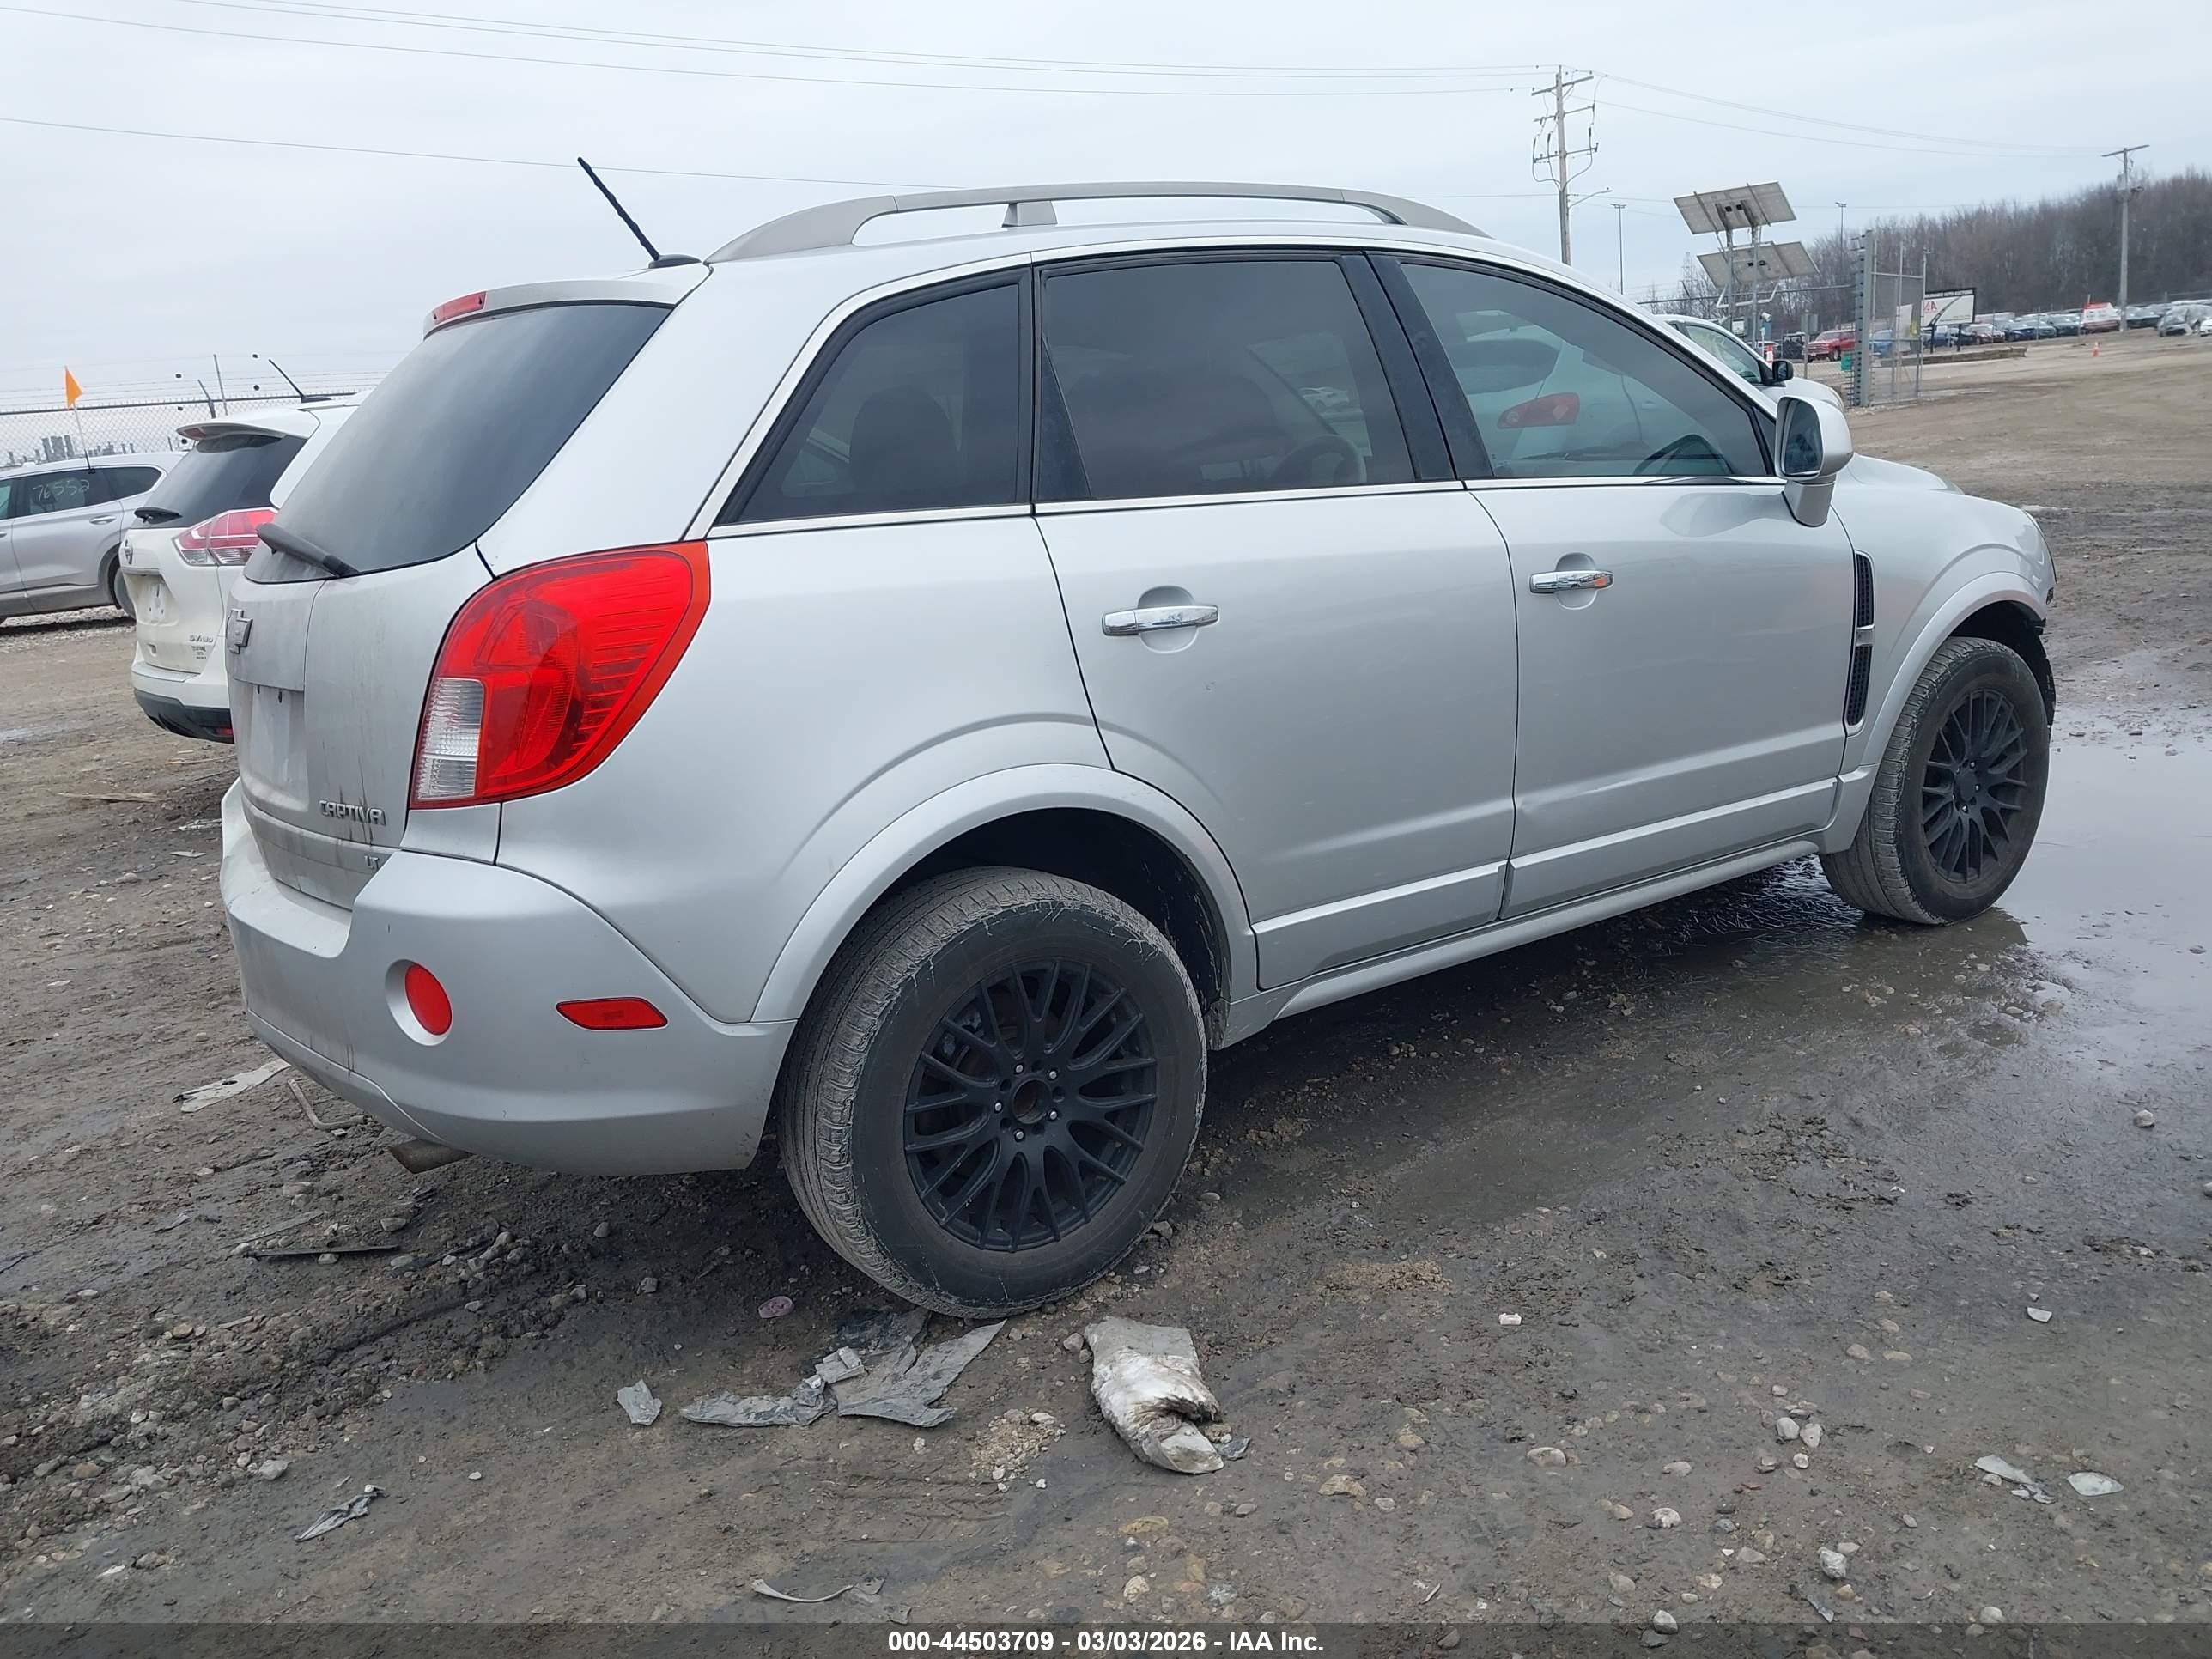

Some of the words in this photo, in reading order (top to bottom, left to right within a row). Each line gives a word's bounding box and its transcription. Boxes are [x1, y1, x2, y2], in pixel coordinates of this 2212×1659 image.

[33, 479, 90, 502] 76552
[319, 799, 386, 826] CAPTIVA
[364, 854, 380, 871] LT
